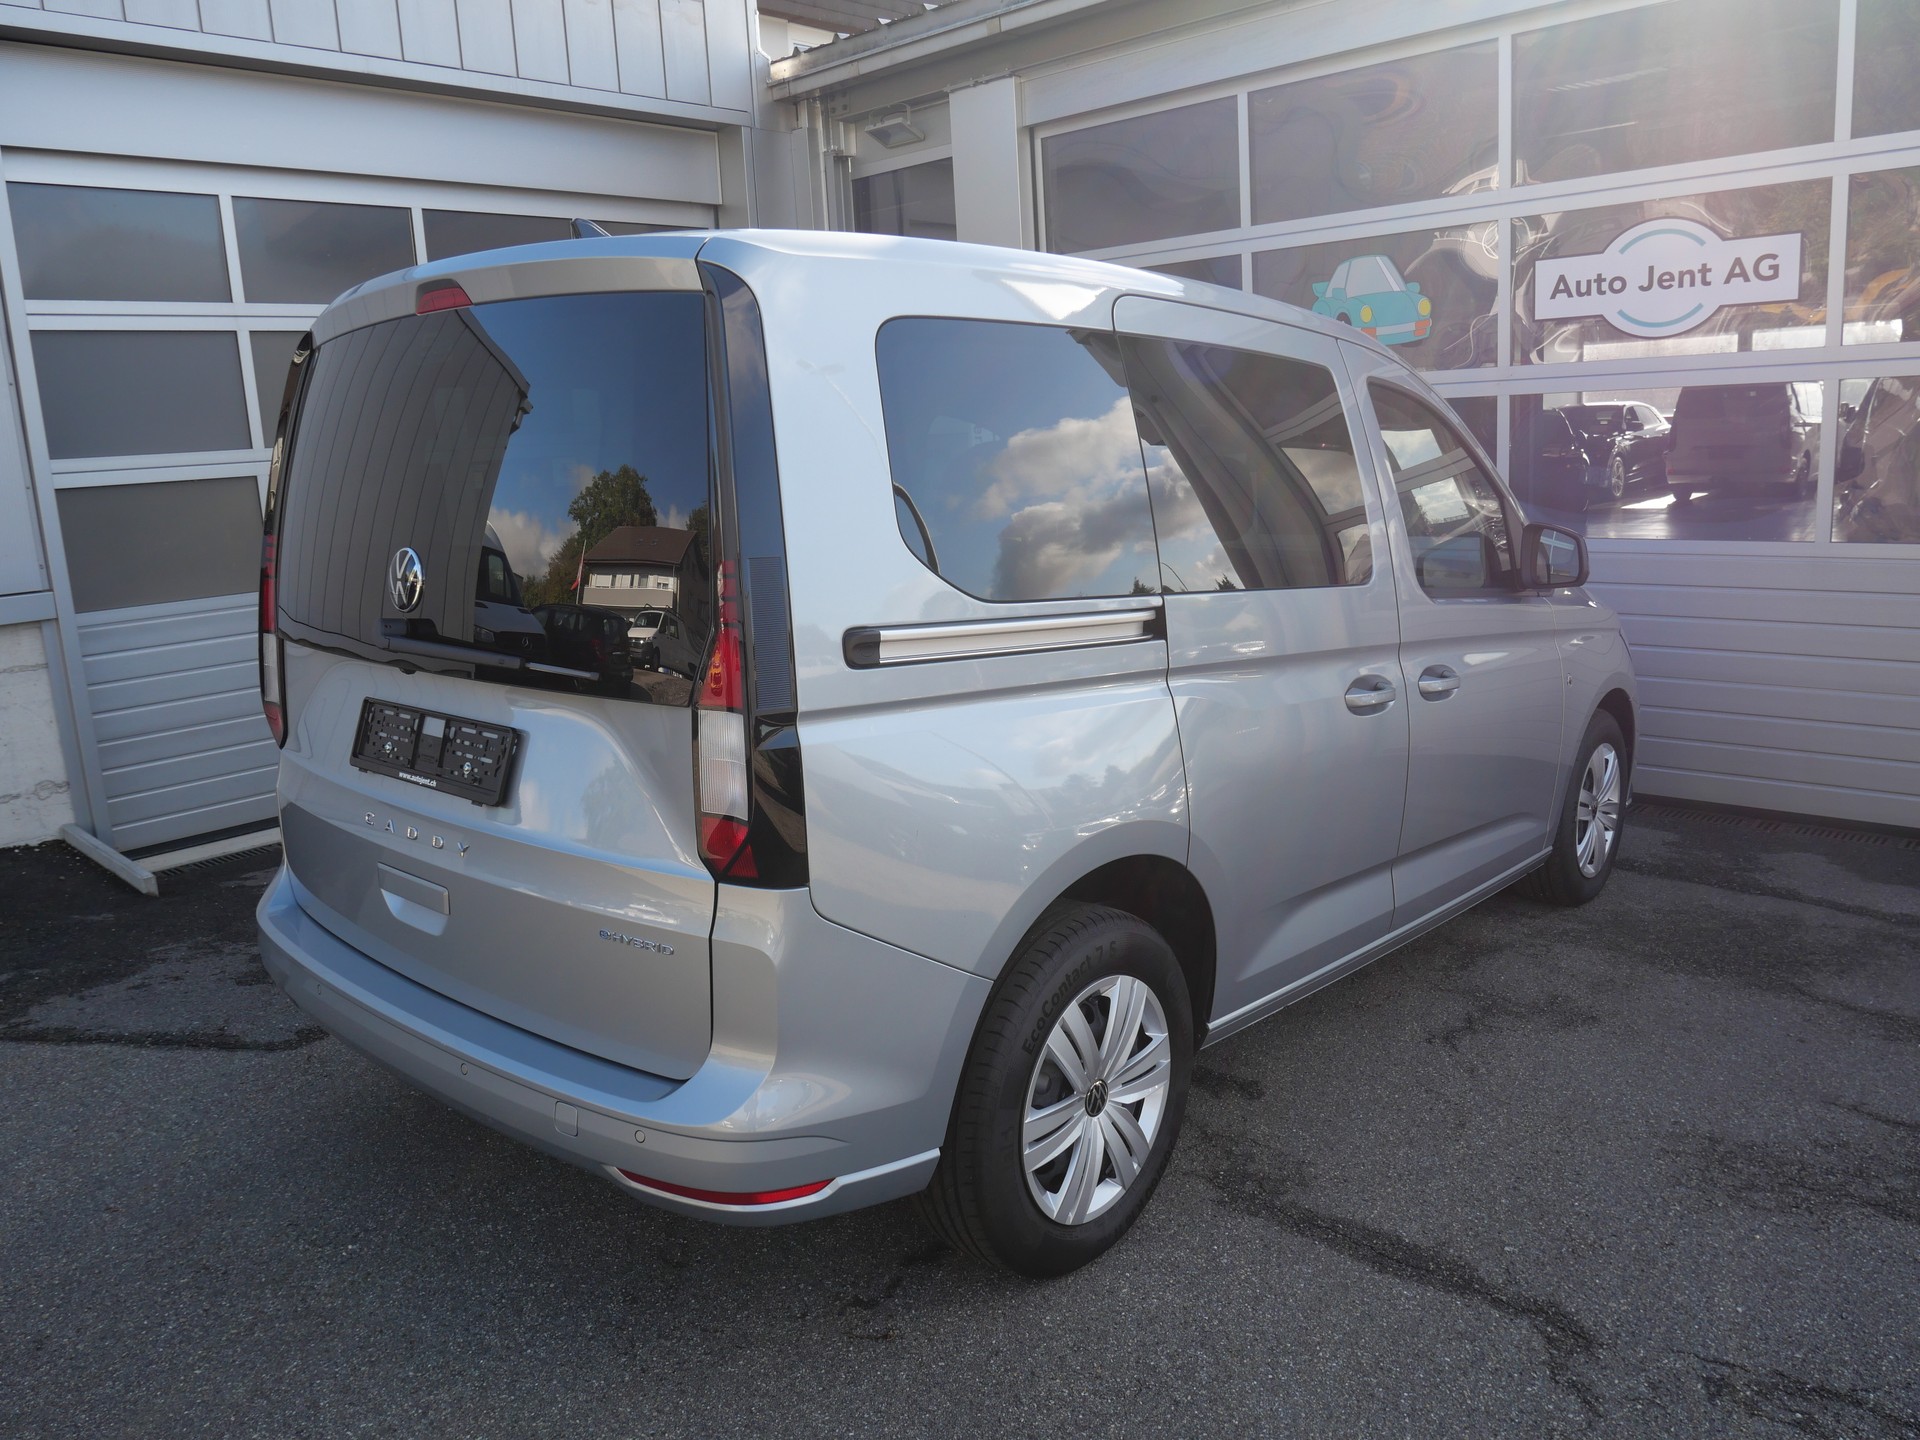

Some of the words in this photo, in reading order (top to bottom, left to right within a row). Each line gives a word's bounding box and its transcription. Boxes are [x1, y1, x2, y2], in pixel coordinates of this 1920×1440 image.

[1549, 273, 1627, 300] Auto
[1637, 262, 1712, 292] Jent
[1723, 253, 1780, 285] AG
[364, 811, 470, 858] CADDY
[1021, 955, 1092, 1055] EcoContact
